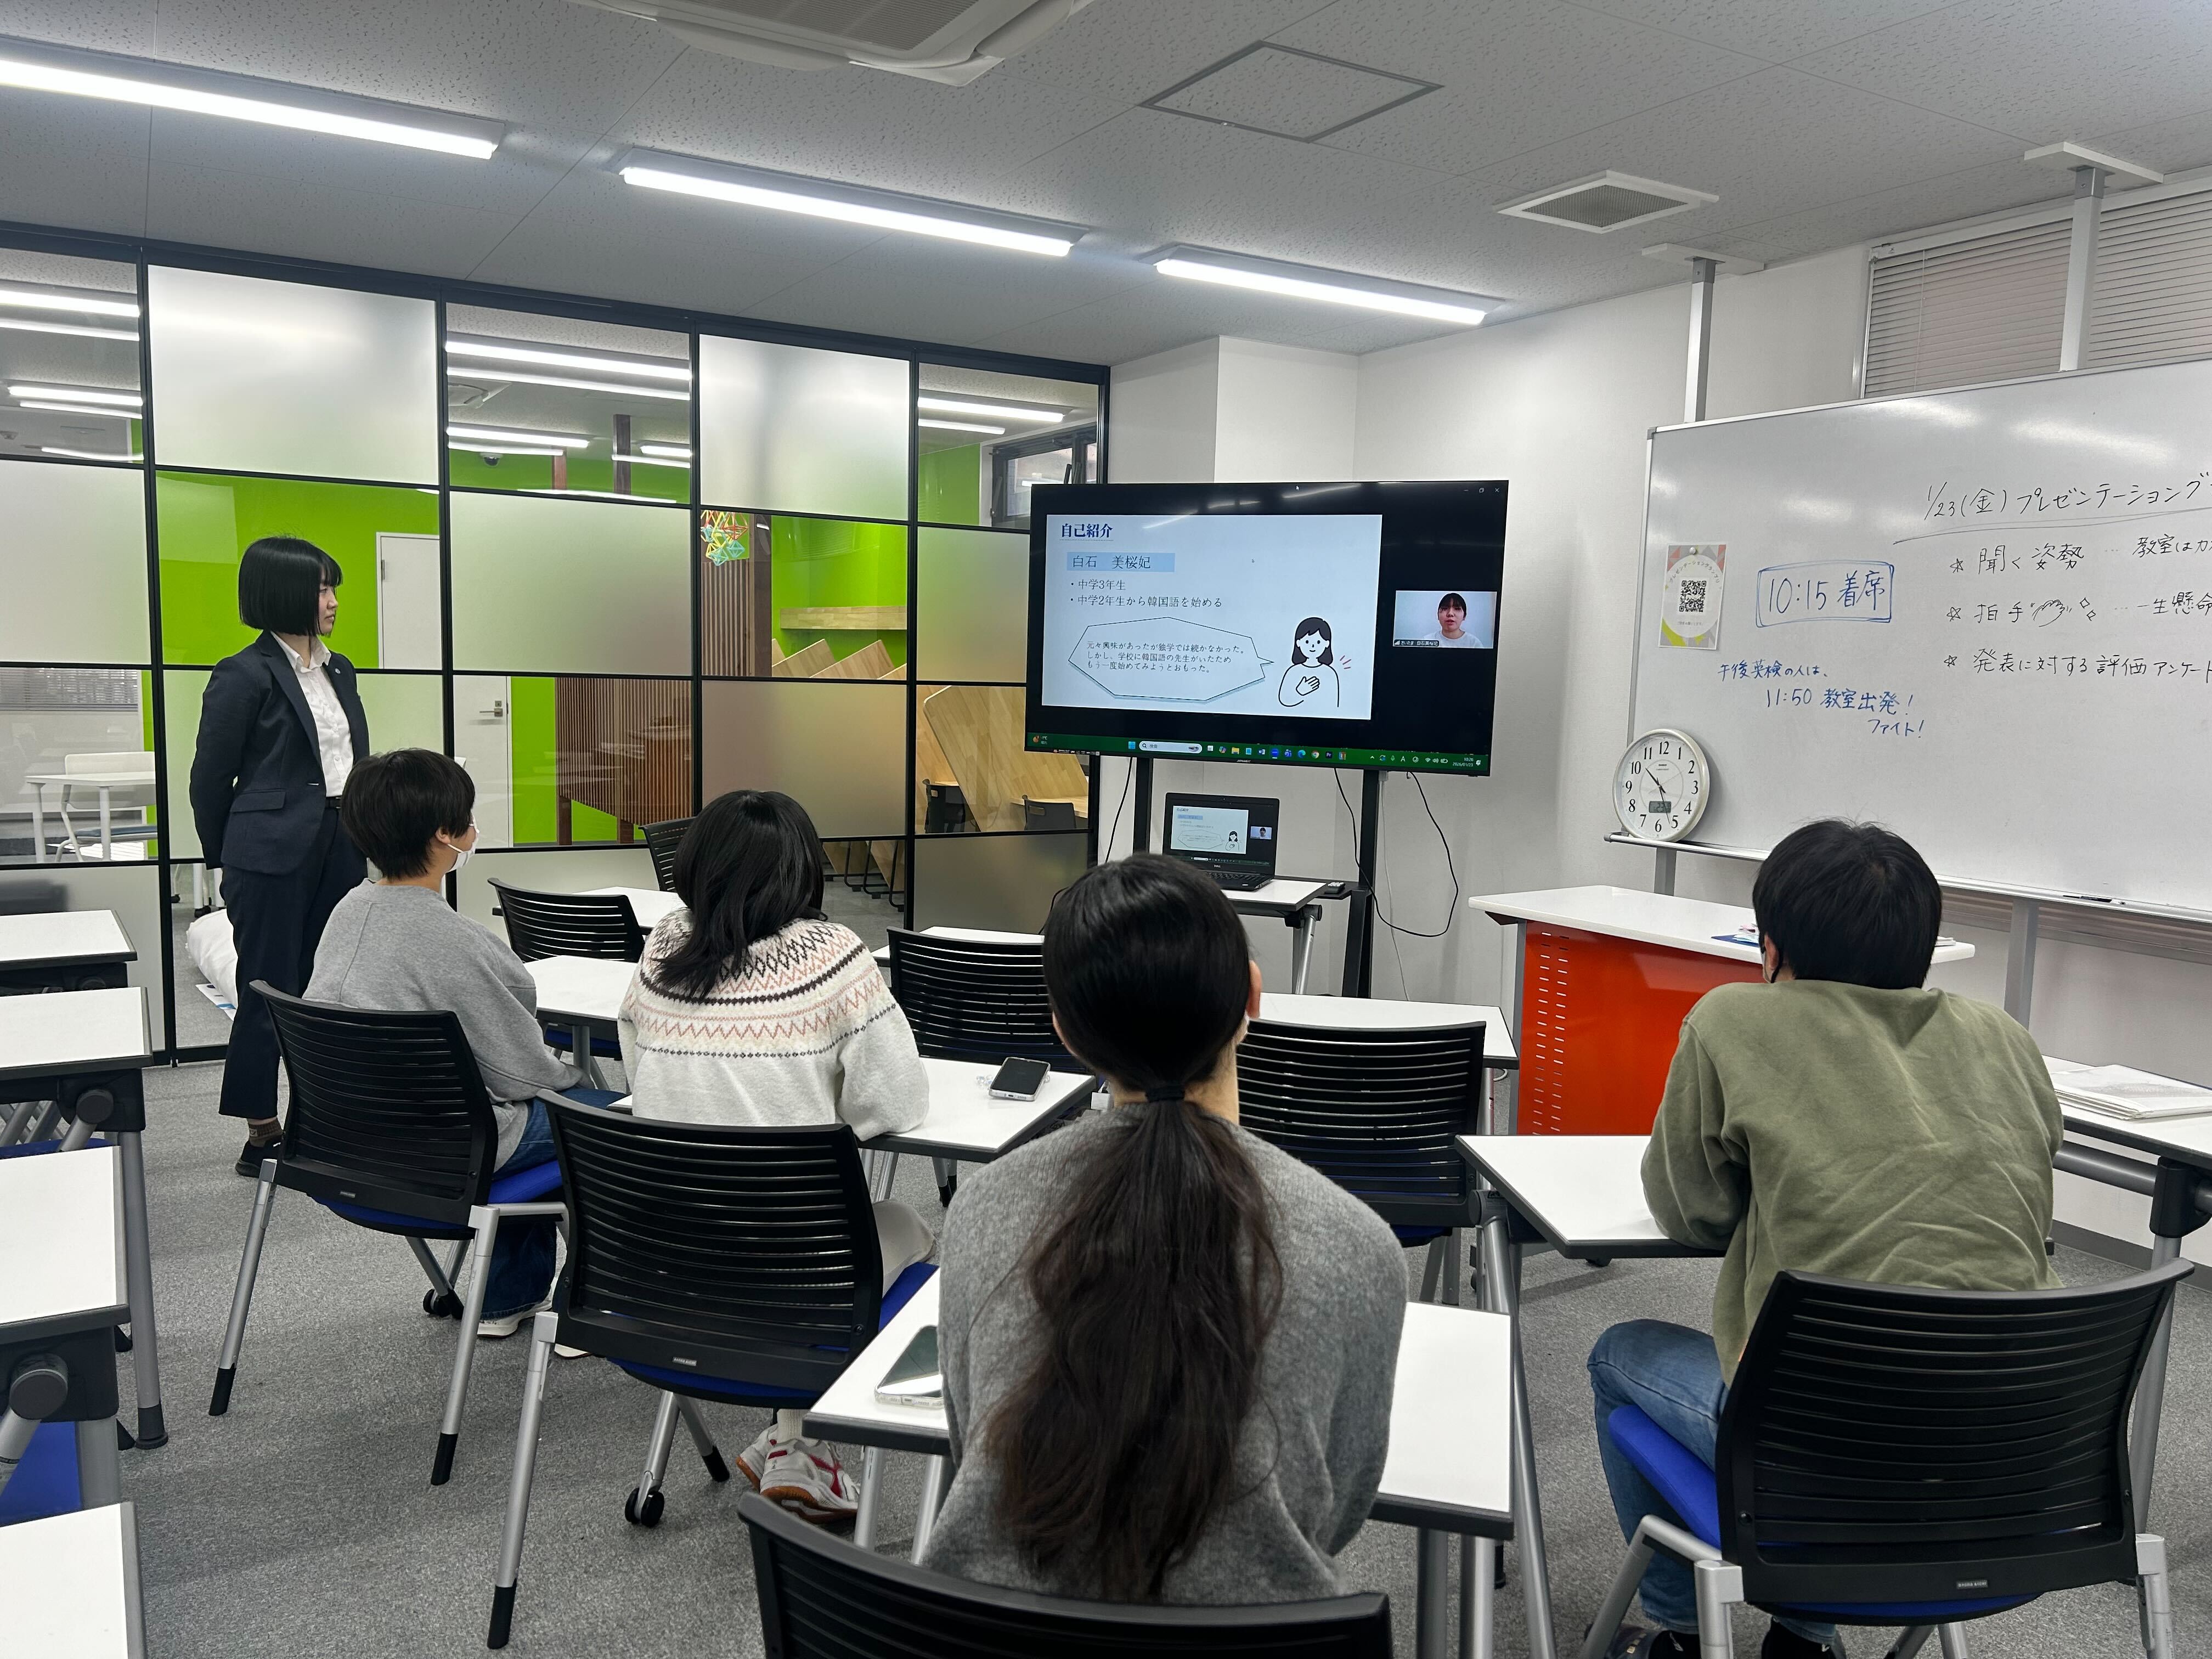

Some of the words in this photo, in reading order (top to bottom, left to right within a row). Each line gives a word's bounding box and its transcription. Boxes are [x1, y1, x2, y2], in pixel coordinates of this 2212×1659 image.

[1062, 523, 1113, 538] 自己紹介
[2132, 533, 2212, 557] 教室はカ
[1073, 556, 1097, 568] 白石
[1644, 746, 1652, 760] 11
[1659, 741, 1669, 755] 12
[1678, 746, 1681, 760] 1
[1631, 761, 1641, 774] 10
[1688, 760, 1695, 774] 2
[1626, 781, 1632, 794] 9
[1691, 781, 1699, 794] 3
[1628, 799, 1635, 812] 8
[1683, 801, 1692, 814] 4
[1640, 814, 1647, 827] 7
[1655, 819, 1662, 832] 6
[1671, 815, 1678, 828] 5
